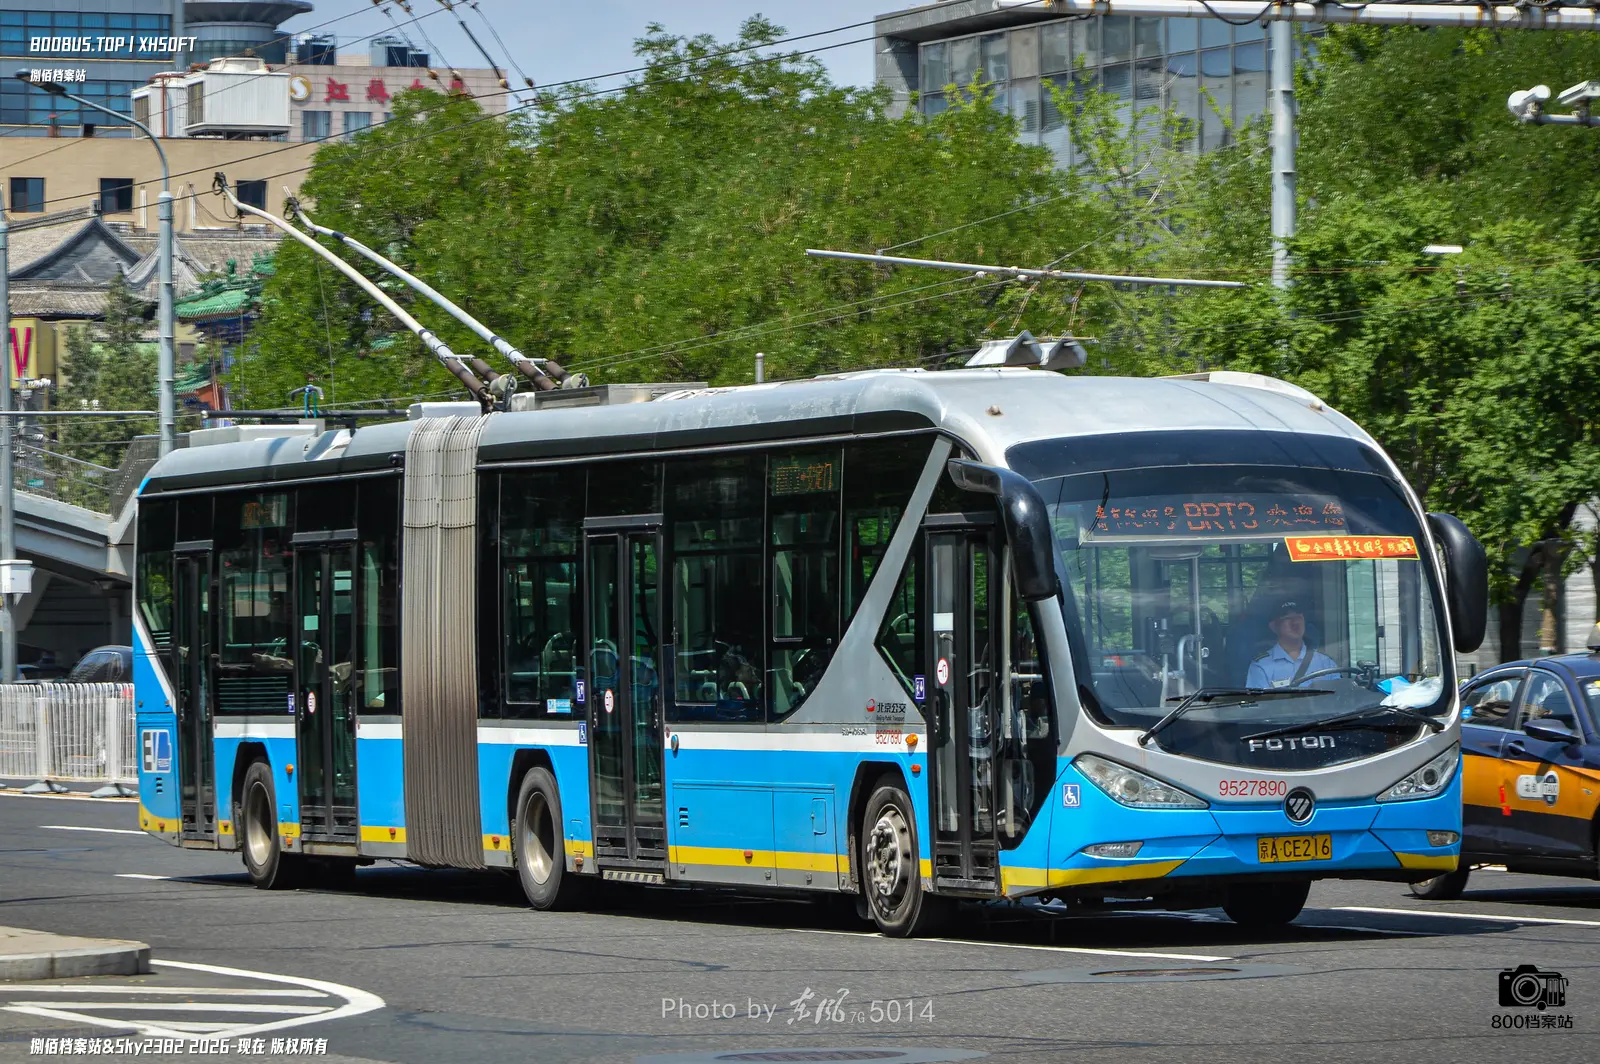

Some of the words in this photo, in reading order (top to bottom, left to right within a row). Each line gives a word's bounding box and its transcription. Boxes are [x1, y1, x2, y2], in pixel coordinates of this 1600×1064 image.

[876, 702, 907, 714] 北京公交
[1248, 735, 1336, 752] FOTON
[1219, 780, 1287, 796] 9527890
